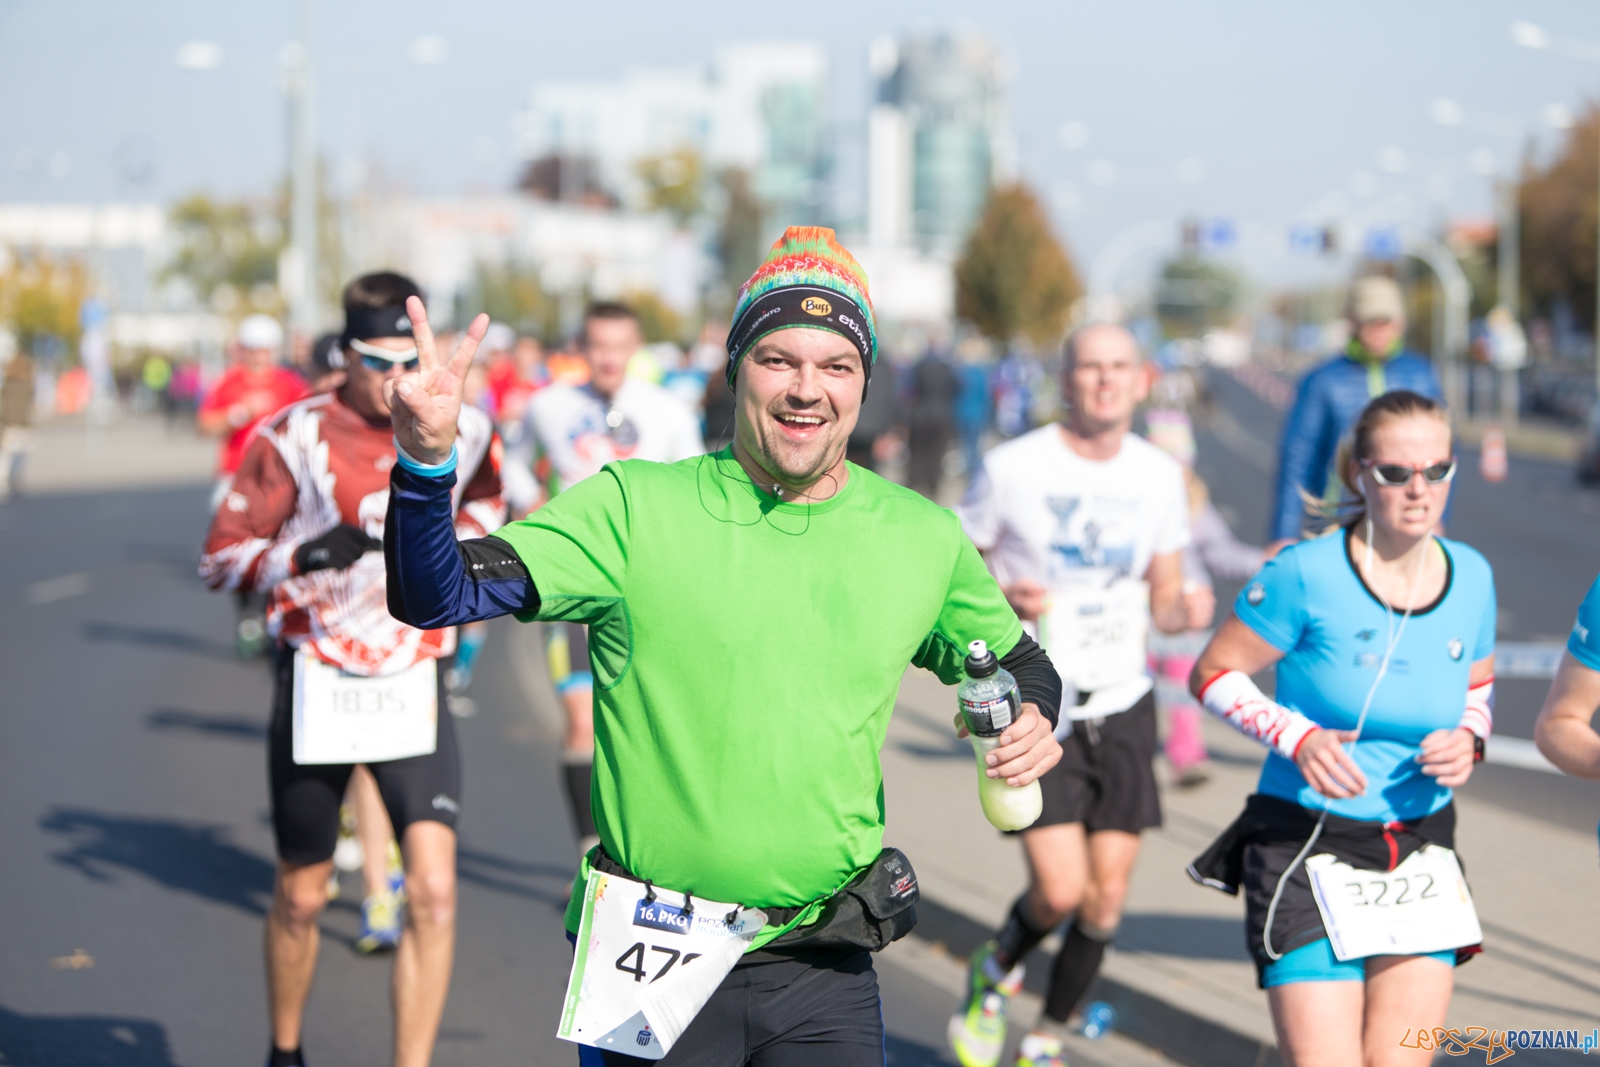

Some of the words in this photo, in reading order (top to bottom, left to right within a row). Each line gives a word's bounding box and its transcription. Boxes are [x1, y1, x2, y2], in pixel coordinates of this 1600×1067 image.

[331, 687, 407, 715] 1835
[1344, 873, 1439, 907] 3222
[639, 906, 656, 922] 16.
[657, 908, 688, 927] PKO
